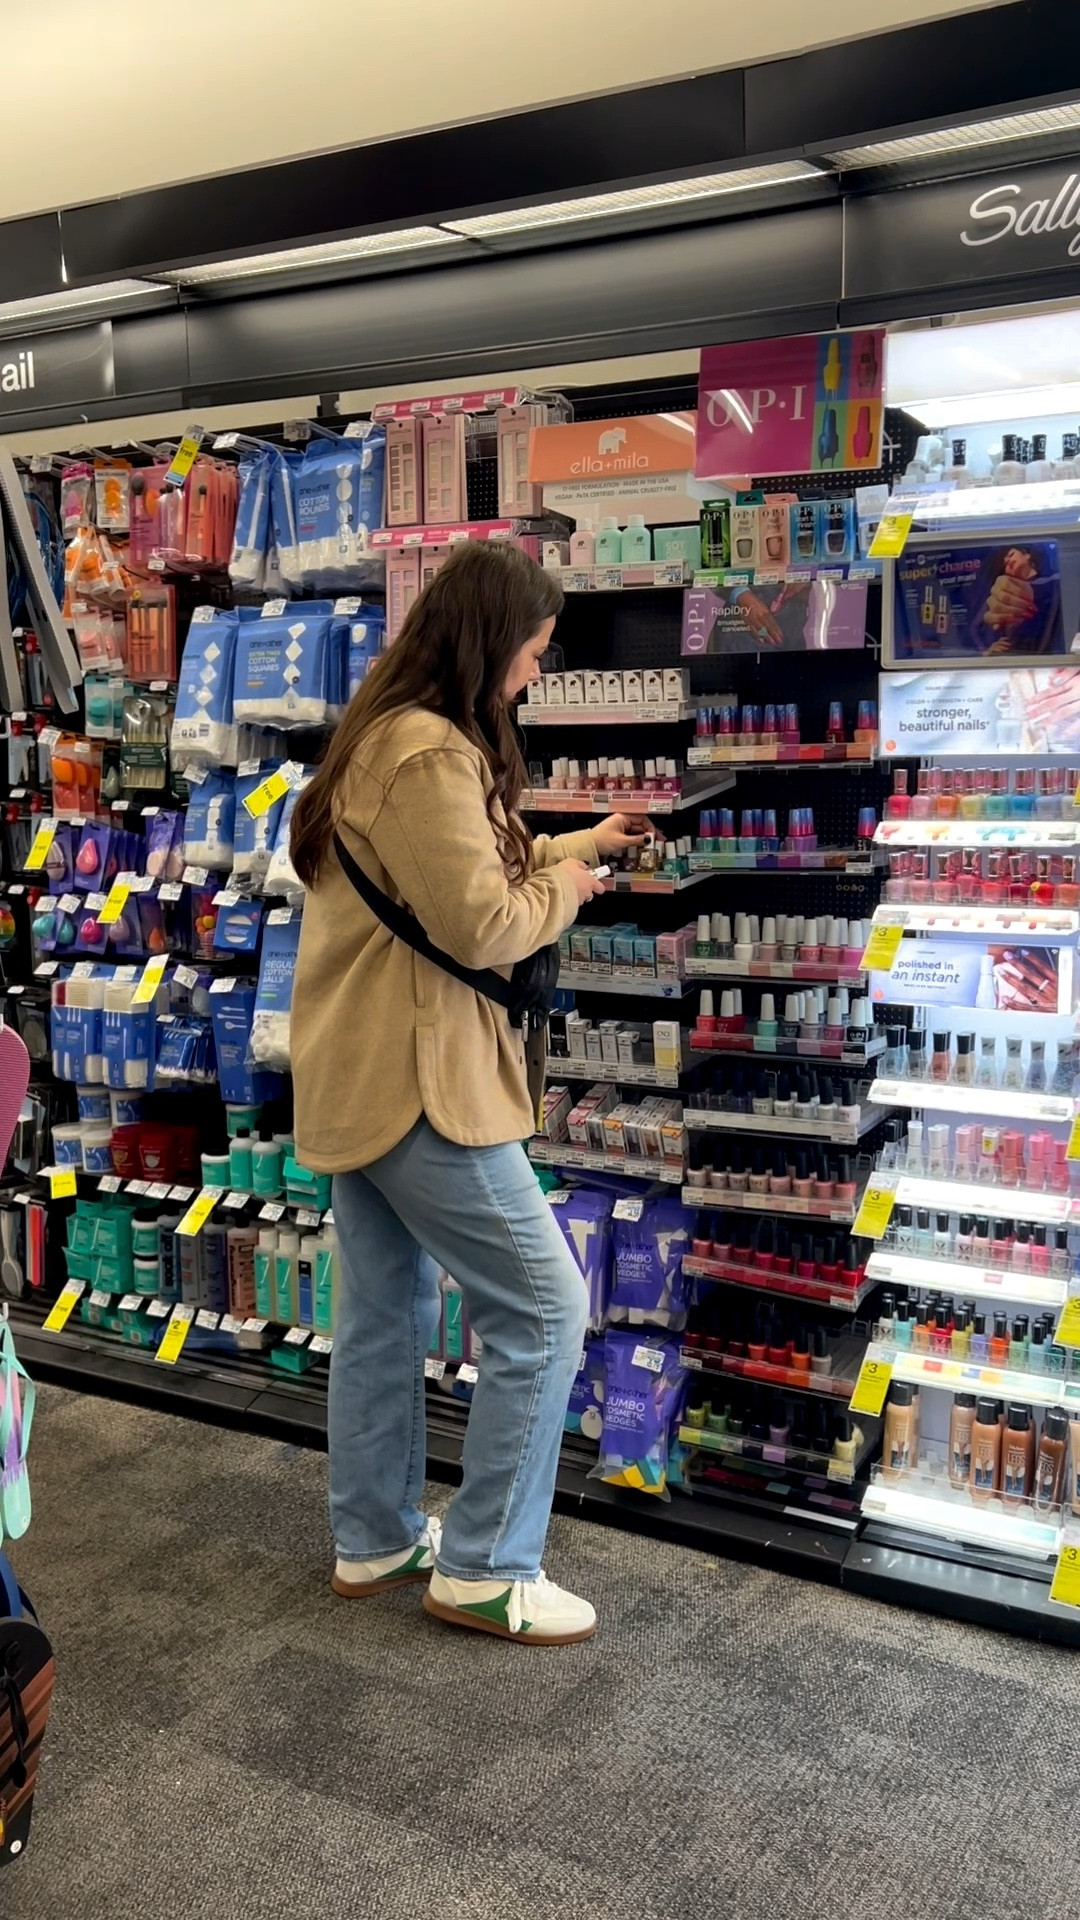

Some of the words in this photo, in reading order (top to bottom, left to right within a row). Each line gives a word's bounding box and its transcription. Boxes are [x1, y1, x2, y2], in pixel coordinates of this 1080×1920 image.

[0, 351, 35, 392] ail
[570, 452, 649, 474] ella+mila
[581, 482, 619, 490] FORMULATION
[590, 490, 615, 498] CERTIFIED
[618, 488, 639, 496] ANIMAL
[640, 485, 677, 494] CRUELTY-FREE
[939, 559, 981, 574] charge
[711, 604, 751, 617] RapiDry
[248, 657, 276, 665] COTTON
[248, 664, 279, 673] SQUARES
[916, 708, 971, 720] stronger,
[899, 720, 954, 732] beautiful
[261, 783, 274, 800] free
[898, 960, 941, 970] polished
[945, 962, 953, 970] in
[891, 970, 909, 981] an
[912, 969, 960, 984] instant
[616, 1252, 652, 1264] JUMBO
[606, 1396, 645, 1412] JUMBO
[1007, 1453, 1026, 1465] LEGS
